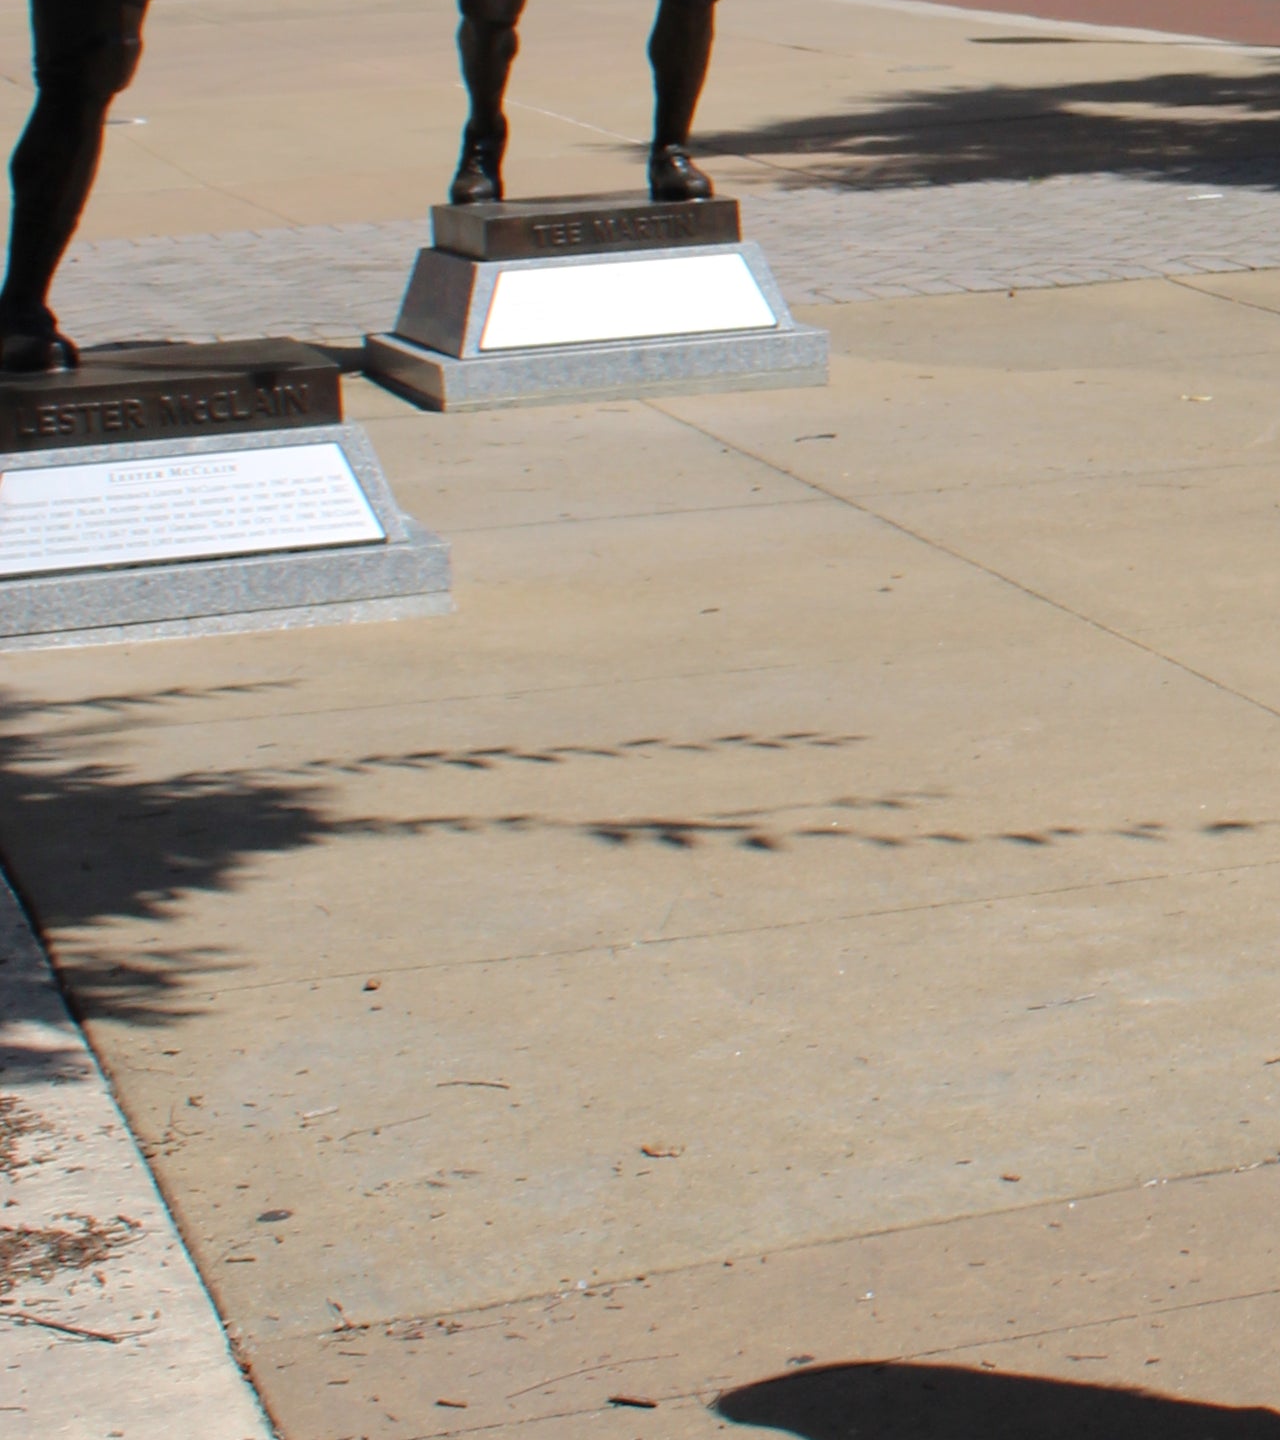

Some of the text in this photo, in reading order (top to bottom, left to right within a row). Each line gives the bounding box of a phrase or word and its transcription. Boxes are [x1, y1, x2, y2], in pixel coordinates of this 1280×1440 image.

[533, 212, 695, 247] TEE MARTIN
[16, 398, 145, 438] LESTER
